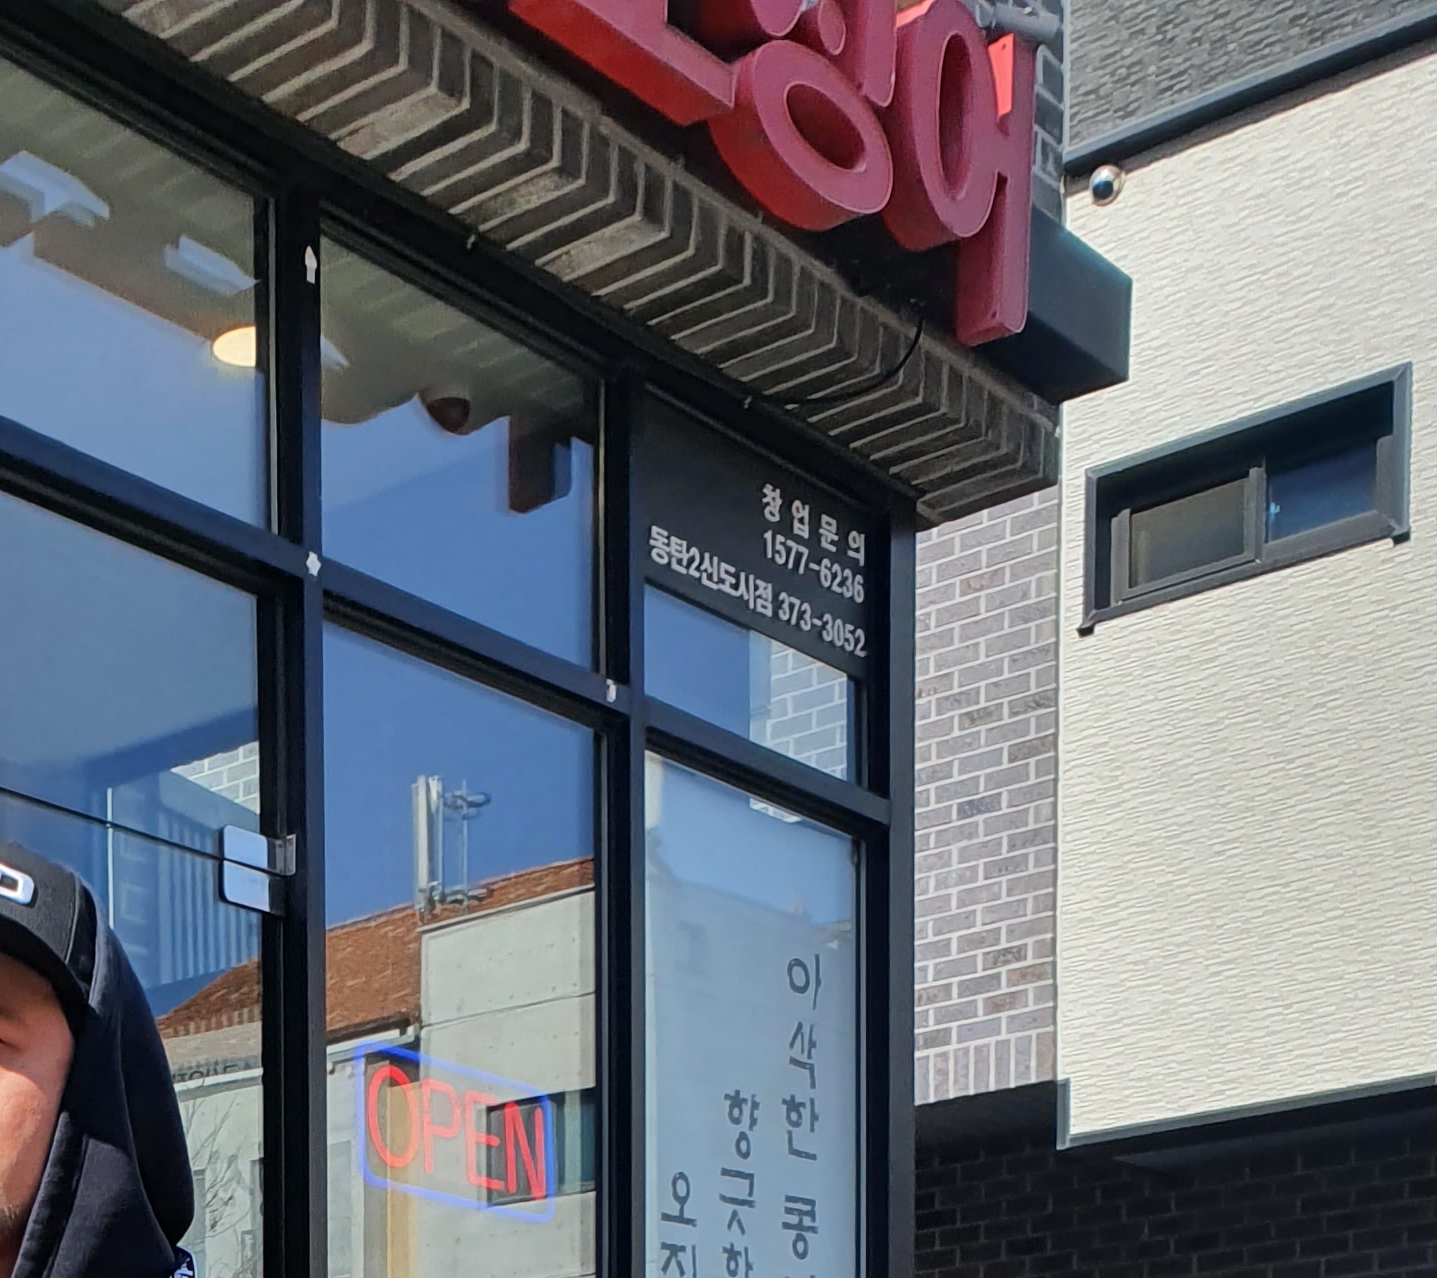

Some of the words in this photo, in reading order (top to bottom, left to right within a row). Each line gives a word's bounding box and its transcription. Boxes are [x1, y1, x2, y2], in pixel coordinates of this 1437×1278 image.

[649, 525, 773, 618] 동탄2신도시점
[777, 591, 868, 658] 373-3052
[762, 529, 865, 604] 1577-6236
[781, 952, 823, 1162] 아삭한
[365, 1063, 548, 1201] OPEN
